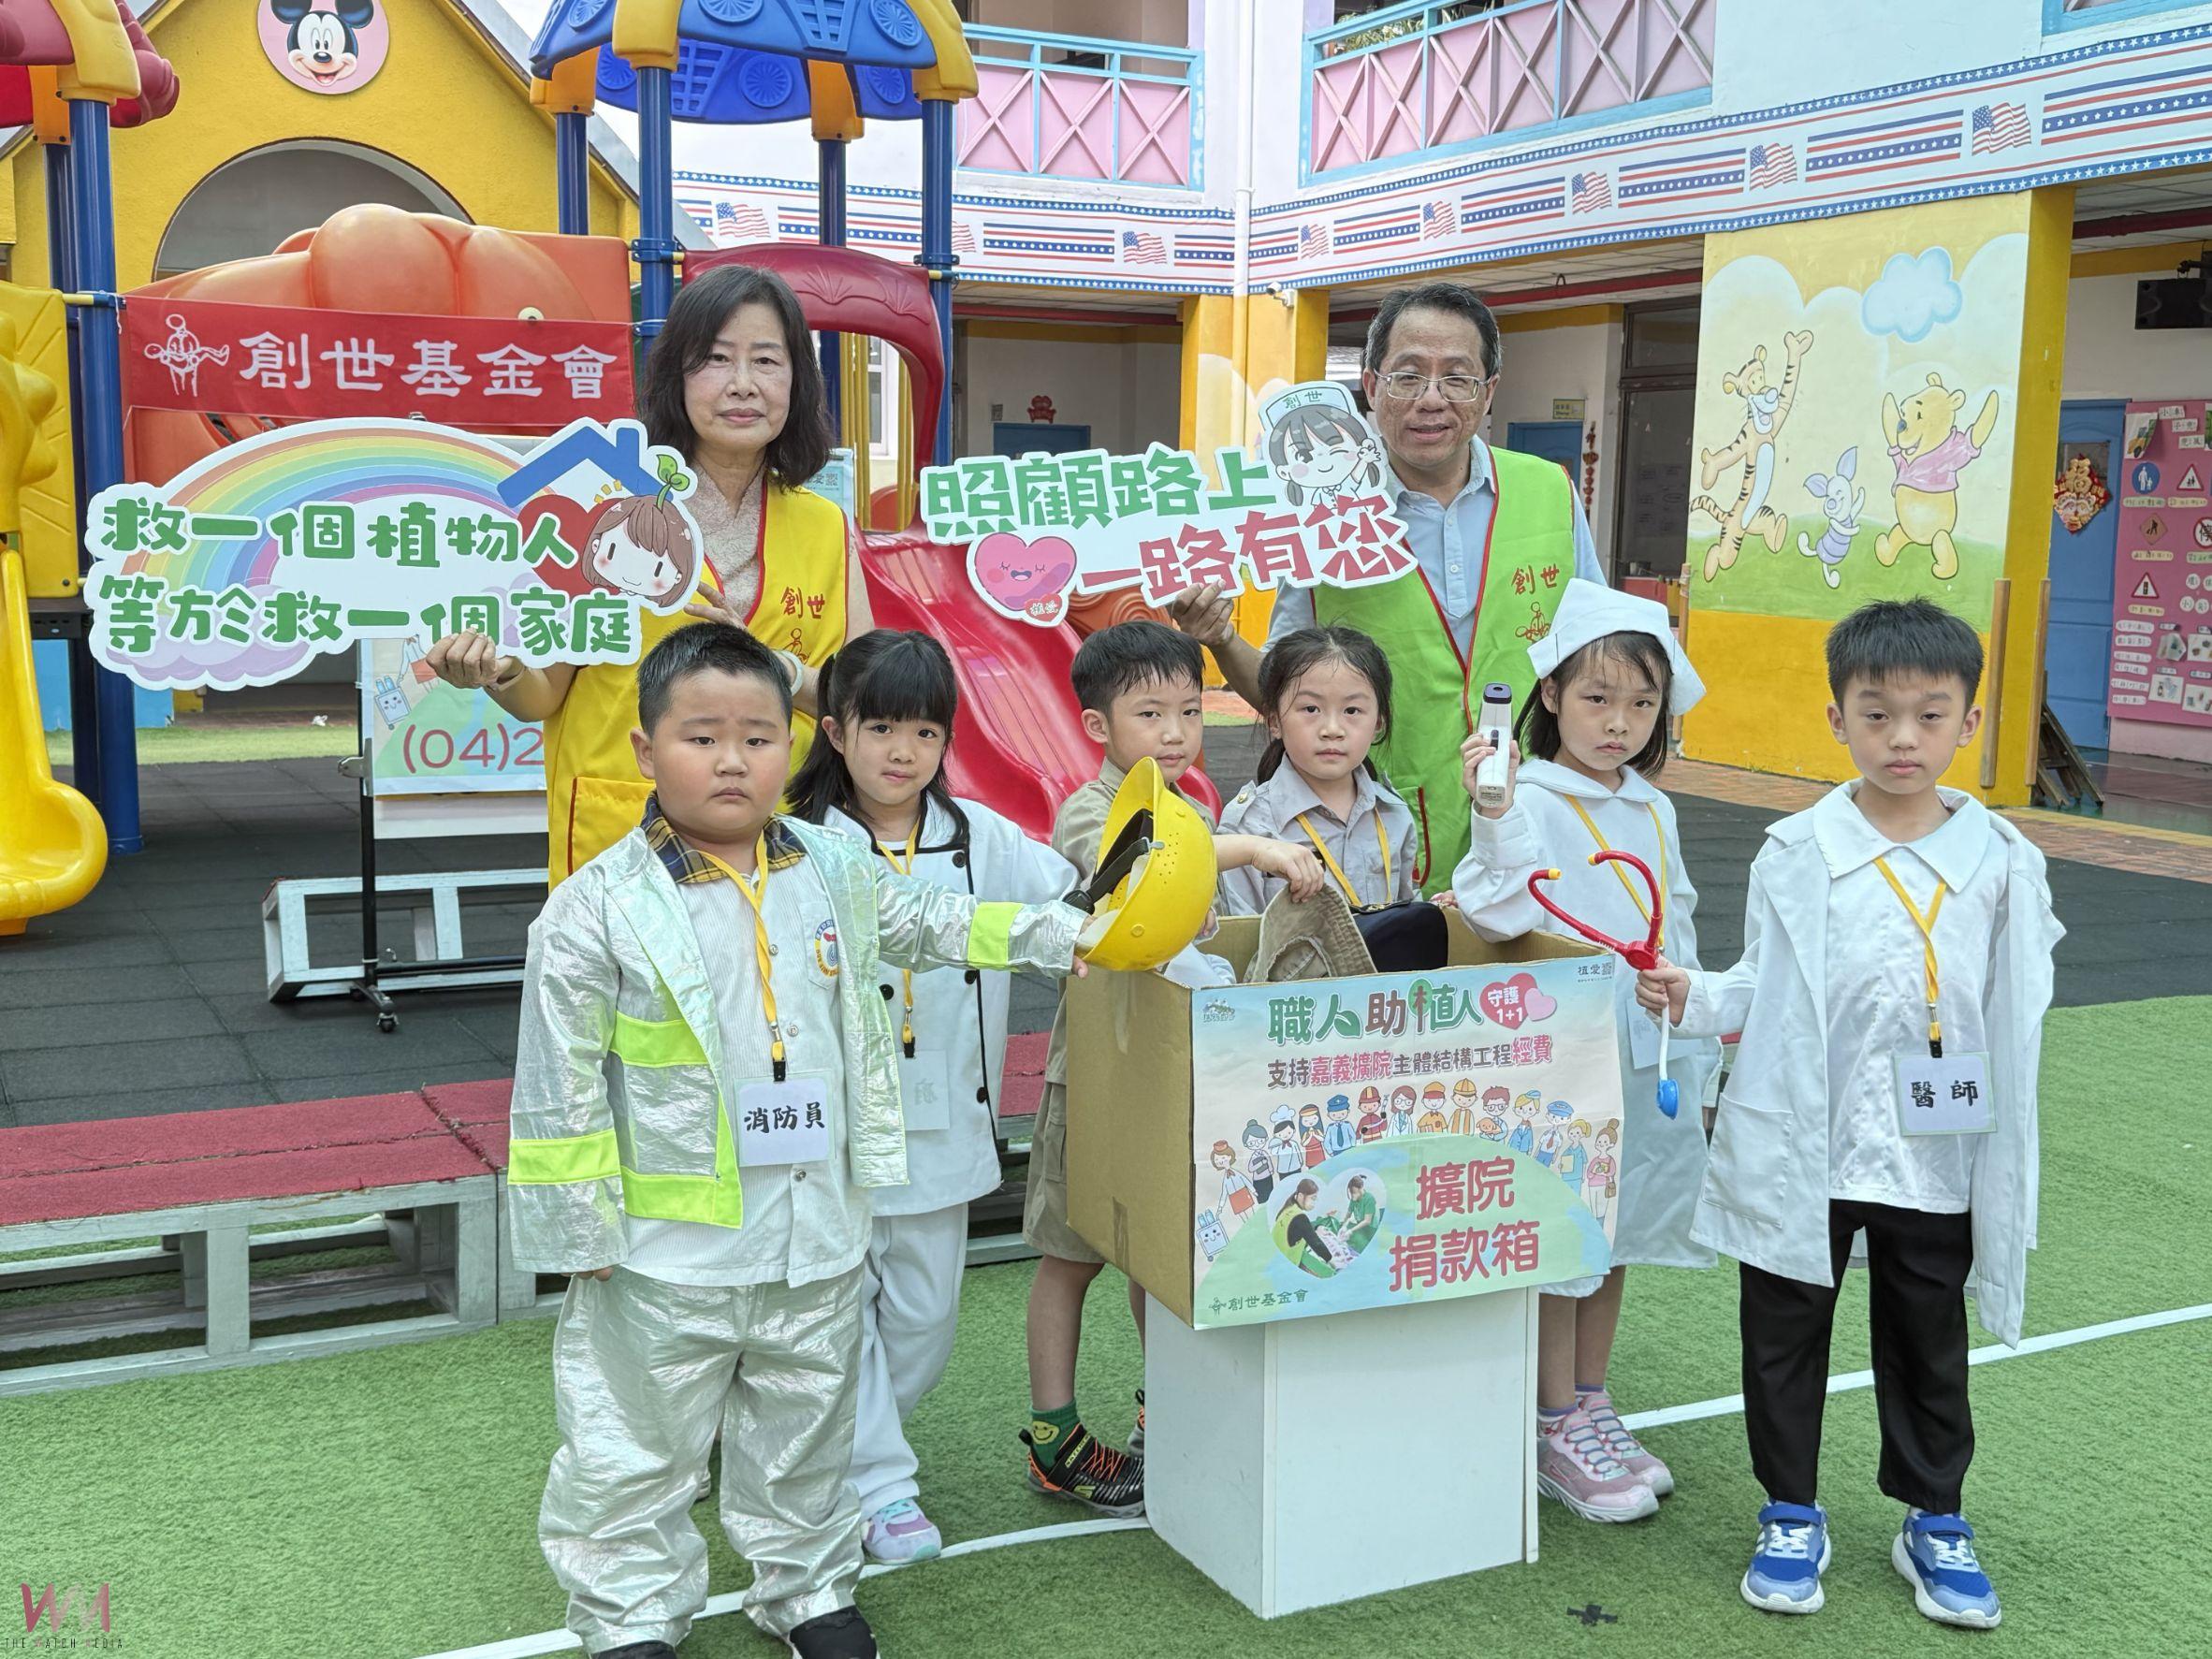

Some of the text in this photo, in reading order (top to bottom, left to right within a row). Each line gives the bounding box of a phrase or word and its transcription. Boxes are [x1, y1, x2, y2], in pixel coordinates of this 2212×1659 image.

[239, 331, 618, 400] 創世基金會
[1283, 390, 1322, 409] 創世
[927, 447, 1277, 537] 照顧路上
[100, 496, 579, 569] 救一個植物人
[1081, 495, 1403, 601] 一路有您
[780, 587, 825, 619] 創世
[1511, 563, 1560, 595] 創世
[98, 575, 632, 656] 等於救一個家庭
[403, 722, 544, 774] (04)2
[1267, 979, 1482, 1045] 職人助植人
[1488, 986, 1520, 1006] 守護
[1496, 1007, 1524, 1024] 1+1
[1267, 1034, 1552, 1089] 支持嘉義擴院主體結構工程經費
[743, 1100, 826, 1135] 消防員
[1911, 1079, 1978, 1110] 醫師
[1416, 1156, 1515, 1220] 擴院
[1389, 1220, 1540, 1292] 捐款箱
[1228, 1288, 1309, 1311] 創世基金會
